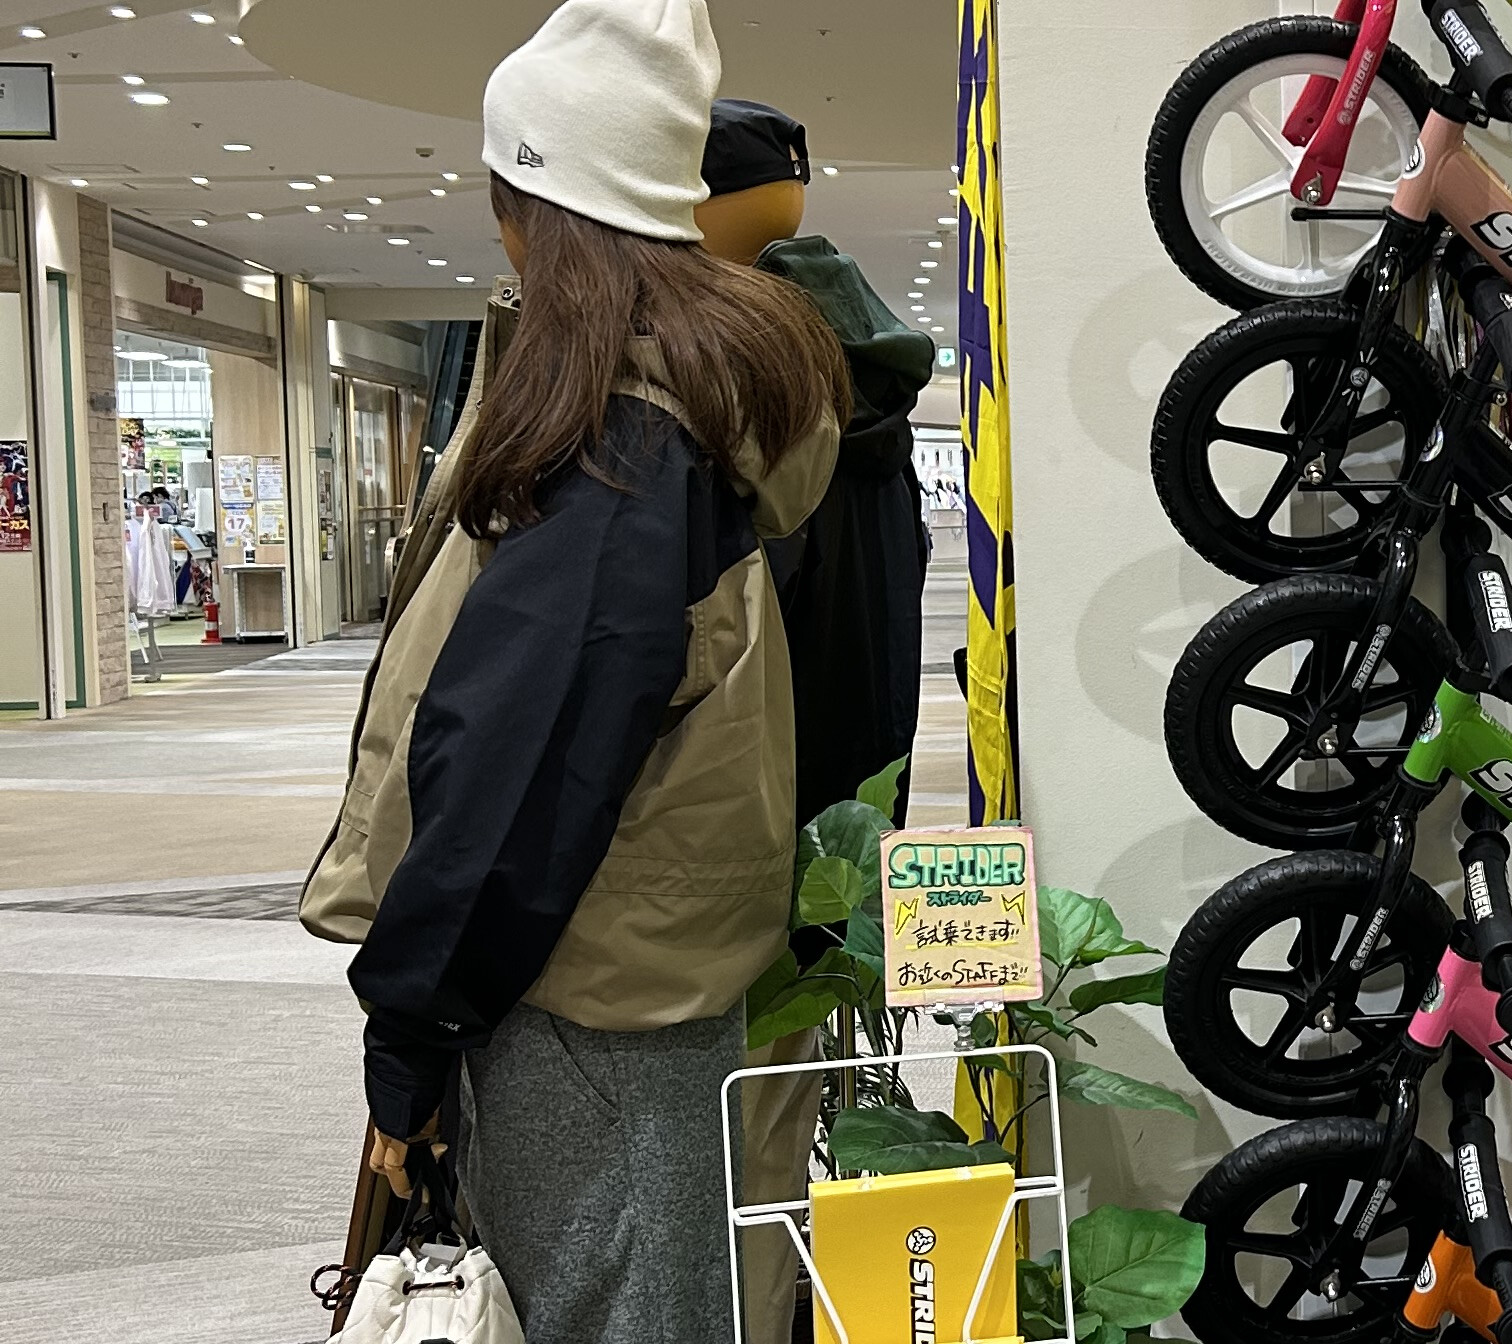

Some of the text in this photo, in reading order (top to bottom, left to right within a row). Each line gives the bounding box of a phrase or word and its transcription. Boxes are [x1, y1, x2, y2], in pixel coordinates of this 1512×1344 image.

[1440, 9, 1482, 66] STRIDER
[1344, 47, 1375, 111] STRIDER
[1352, 635, 1385, 692] STRIDER
[889, 843, 1026, 888] STRIDER
[1466, 860, 1494, 924] STRIDER
[926, 890, 993, 907] ストライダー
[1356, 906, 1389, 962] STRIDER
[1458, 1144, 1488, 1222] STRIDER
